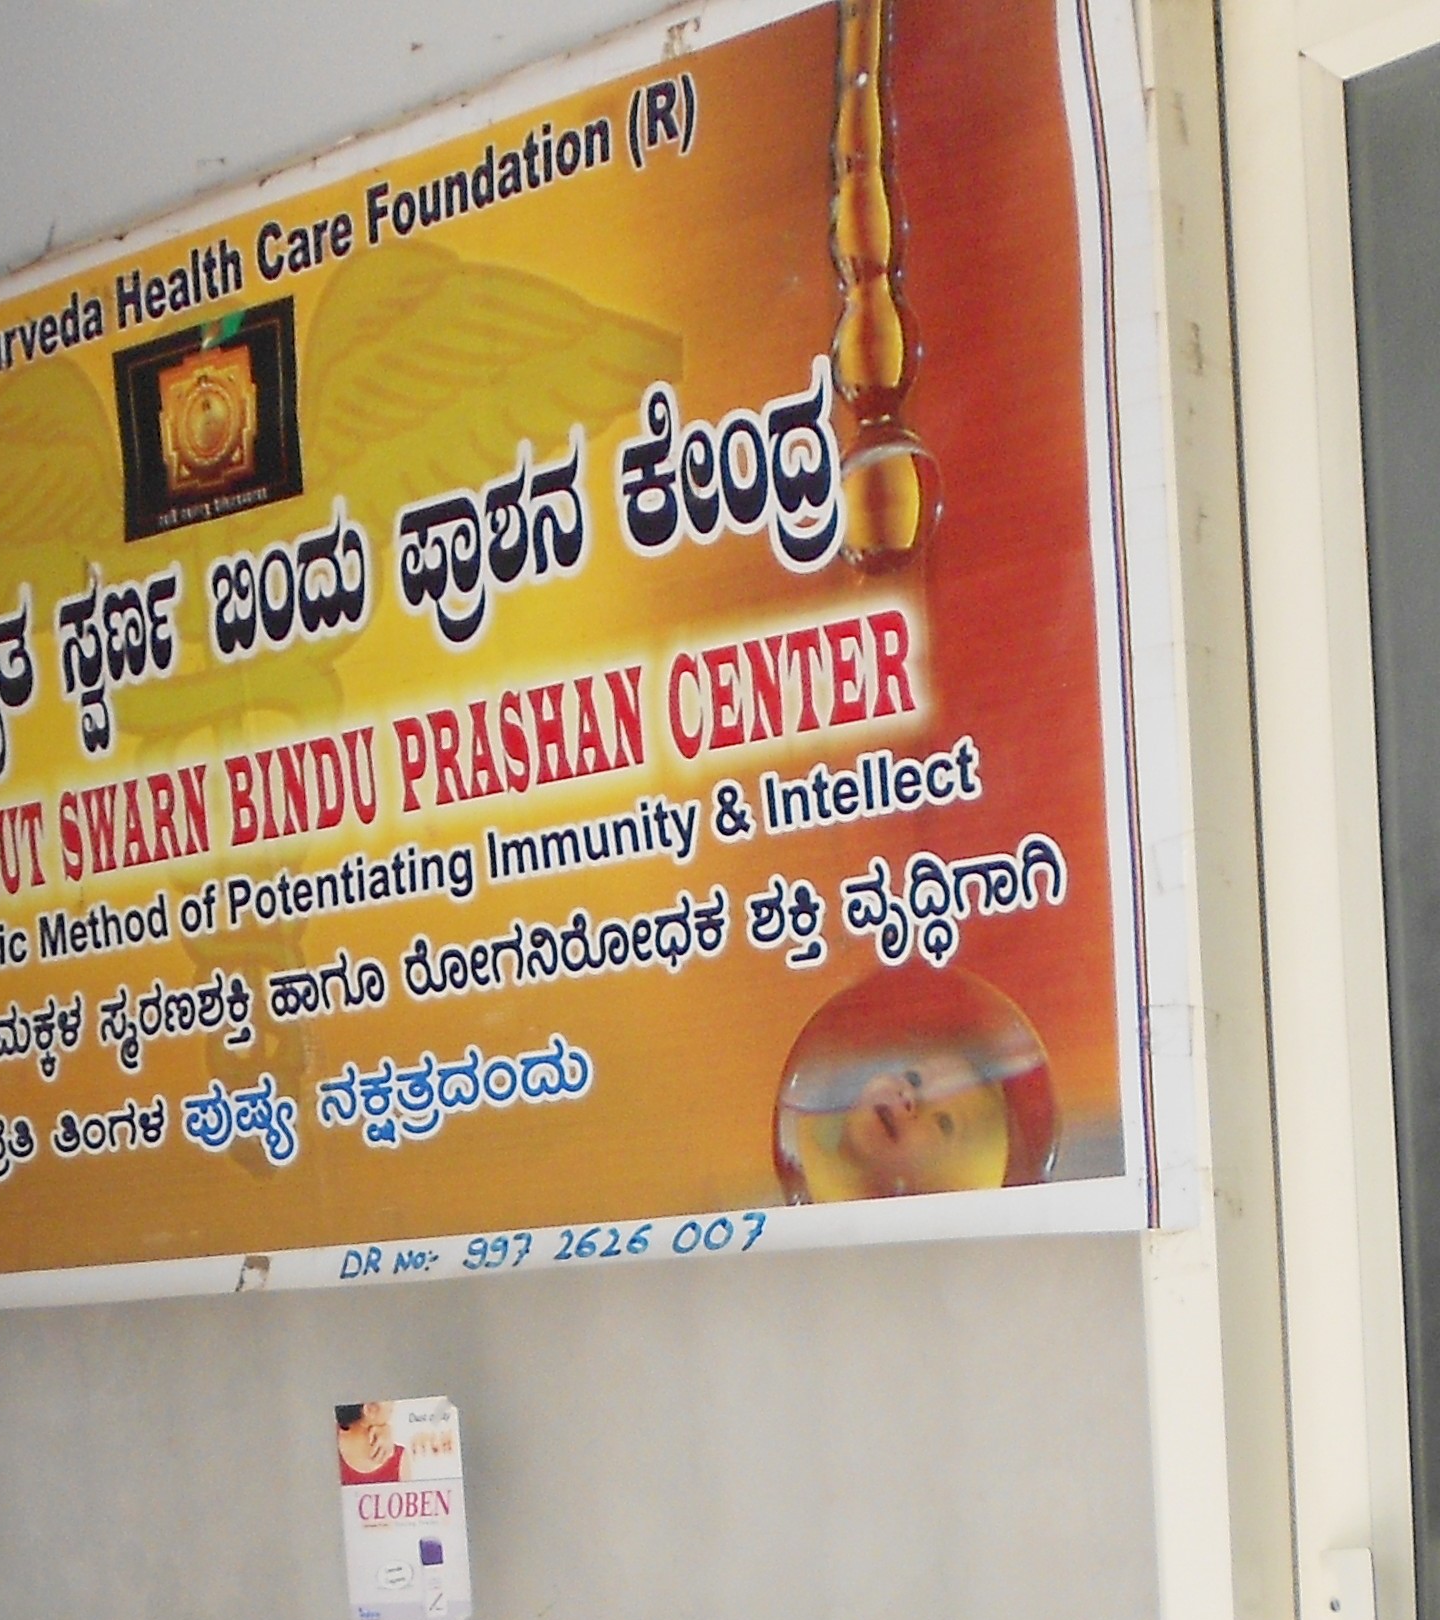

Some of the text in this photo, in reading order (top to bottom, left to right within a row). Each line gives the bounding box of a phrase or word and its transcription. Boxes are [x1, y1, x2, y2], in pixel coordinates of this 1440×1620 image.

[117, 240, 242, 328] Health
[257, 214, 352, 280] Care
[366, 118, 610, 244] Foundation
[628, 74, 695, 168] (R)
[59, 570, 178, 752] ಸ್ವರ್ಣ
[212, 513, 366, 655] ಬಿಂದು
[400, 445, 583, 643] ಪ್ರಾಶನ
[622, 372, 838, 562] ಕೇಂದ್ರ
[60, 764, 210, 881] SWARN
[225, 726, 377, 847] BINDU
[393, 665, 645, 812] PRASHAN
[669, 610, 915, 760] CENTER
[40, 895, 168, 958] Method
[181, 884, 216, 933] of
[229, 847, 474, 925] Potentiating
[487, 800, 696, 878] Immunity
[716, 784, 750, 837] &
[764, 743, 977, 828] Intellect
[270, 953, 385, 1016] ಹಾಗೂ
[750, 880, 821, 962] ಶಕ್ತಿ
[53, 1099, 165, 1153] ತಿಂಗಳ
[184, 1076, 297, 1161] ಪುಷ್ಯ
[319, 1037, 590, 1144] ನಕ್ಷತ್ರದಂದು
[339, 1246, 382, 1280] DR
[462, 1232, 534, 1270] 997
[554, 1223, 654, 1262] 2626
[672, 1211, 768, 1255] 007
[357, 1489, 452, 1521] CLOBEN
